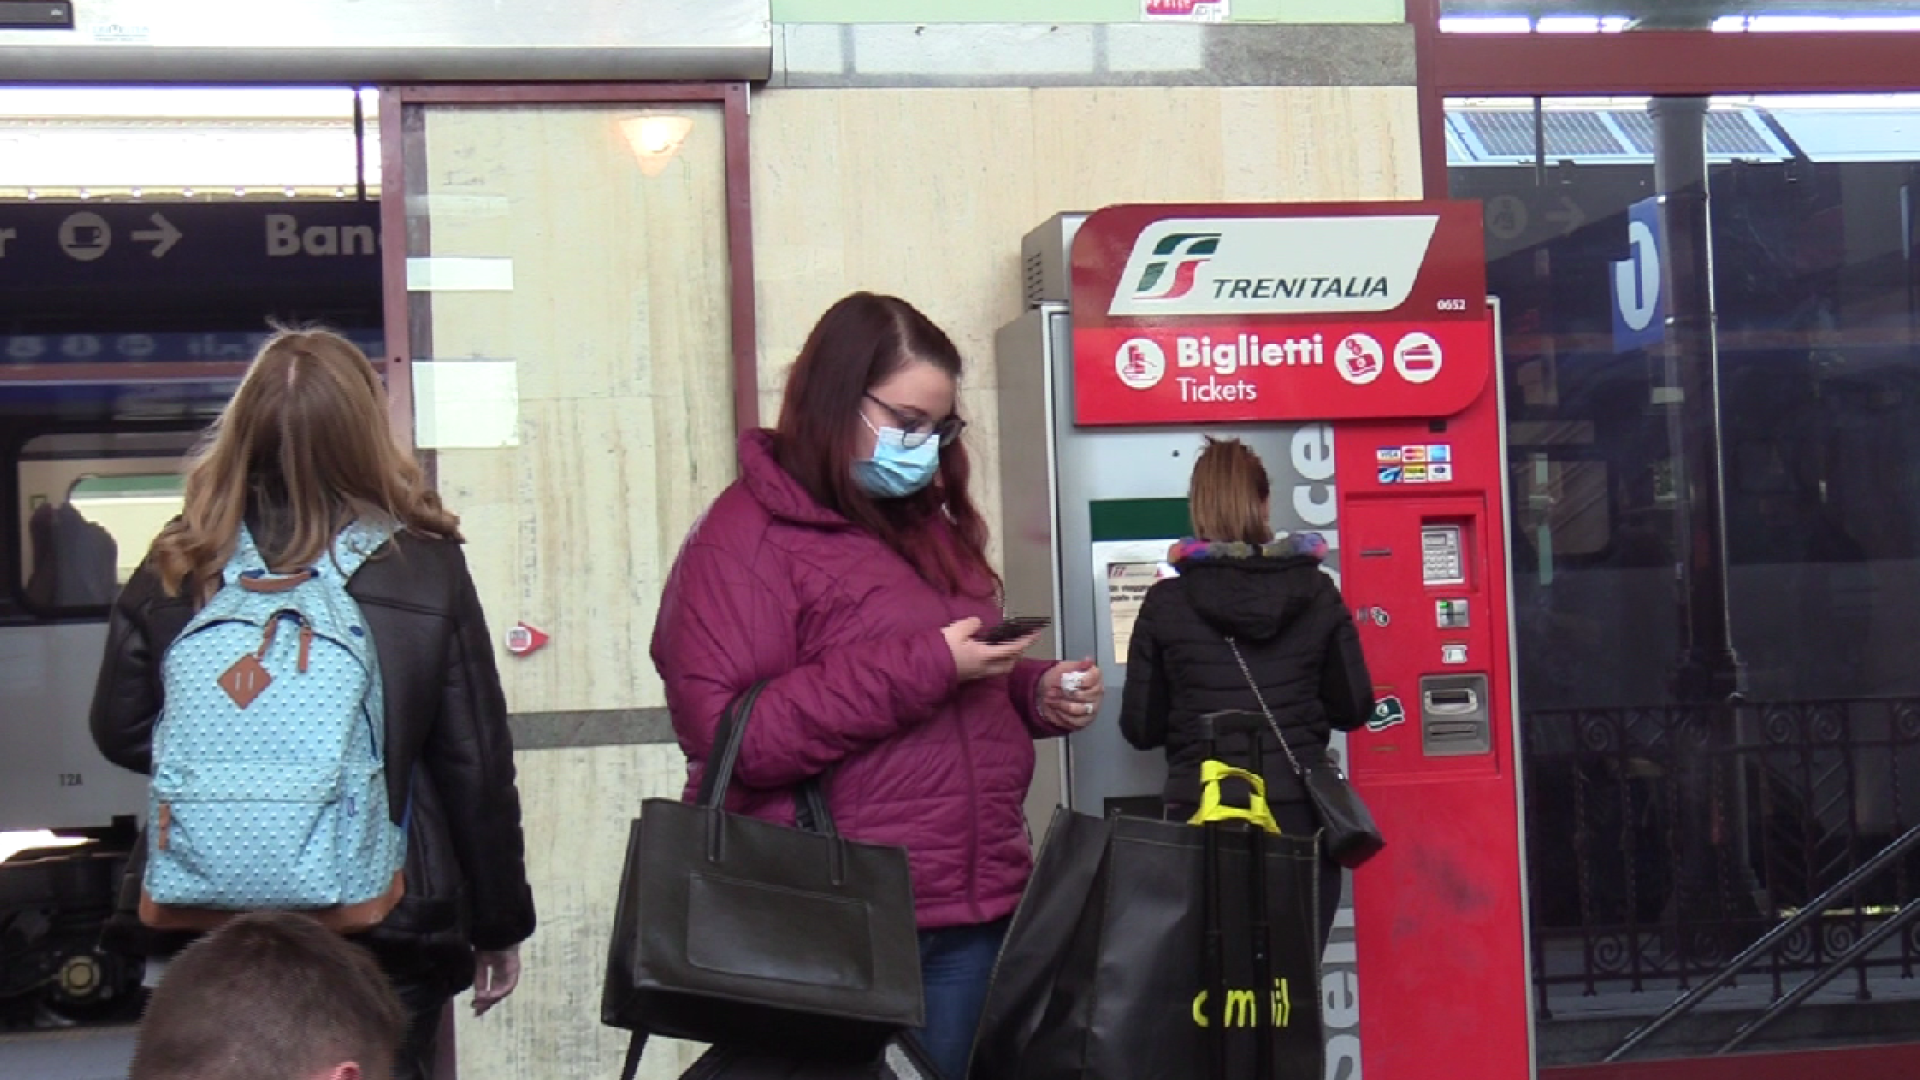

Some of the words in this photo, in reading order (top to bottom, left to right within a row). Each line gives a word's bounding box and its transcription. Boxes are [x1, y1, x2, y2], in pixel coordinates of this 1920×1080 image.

[265, 214, 382, 257] Ban
[1213, 275, 1388, 299] TRENITALIA
[1436, 299, 1466, 311] 0652
[1177, 334, 1324, 374] Biglietti
[1177, 375, 1258, 402] Tickets
